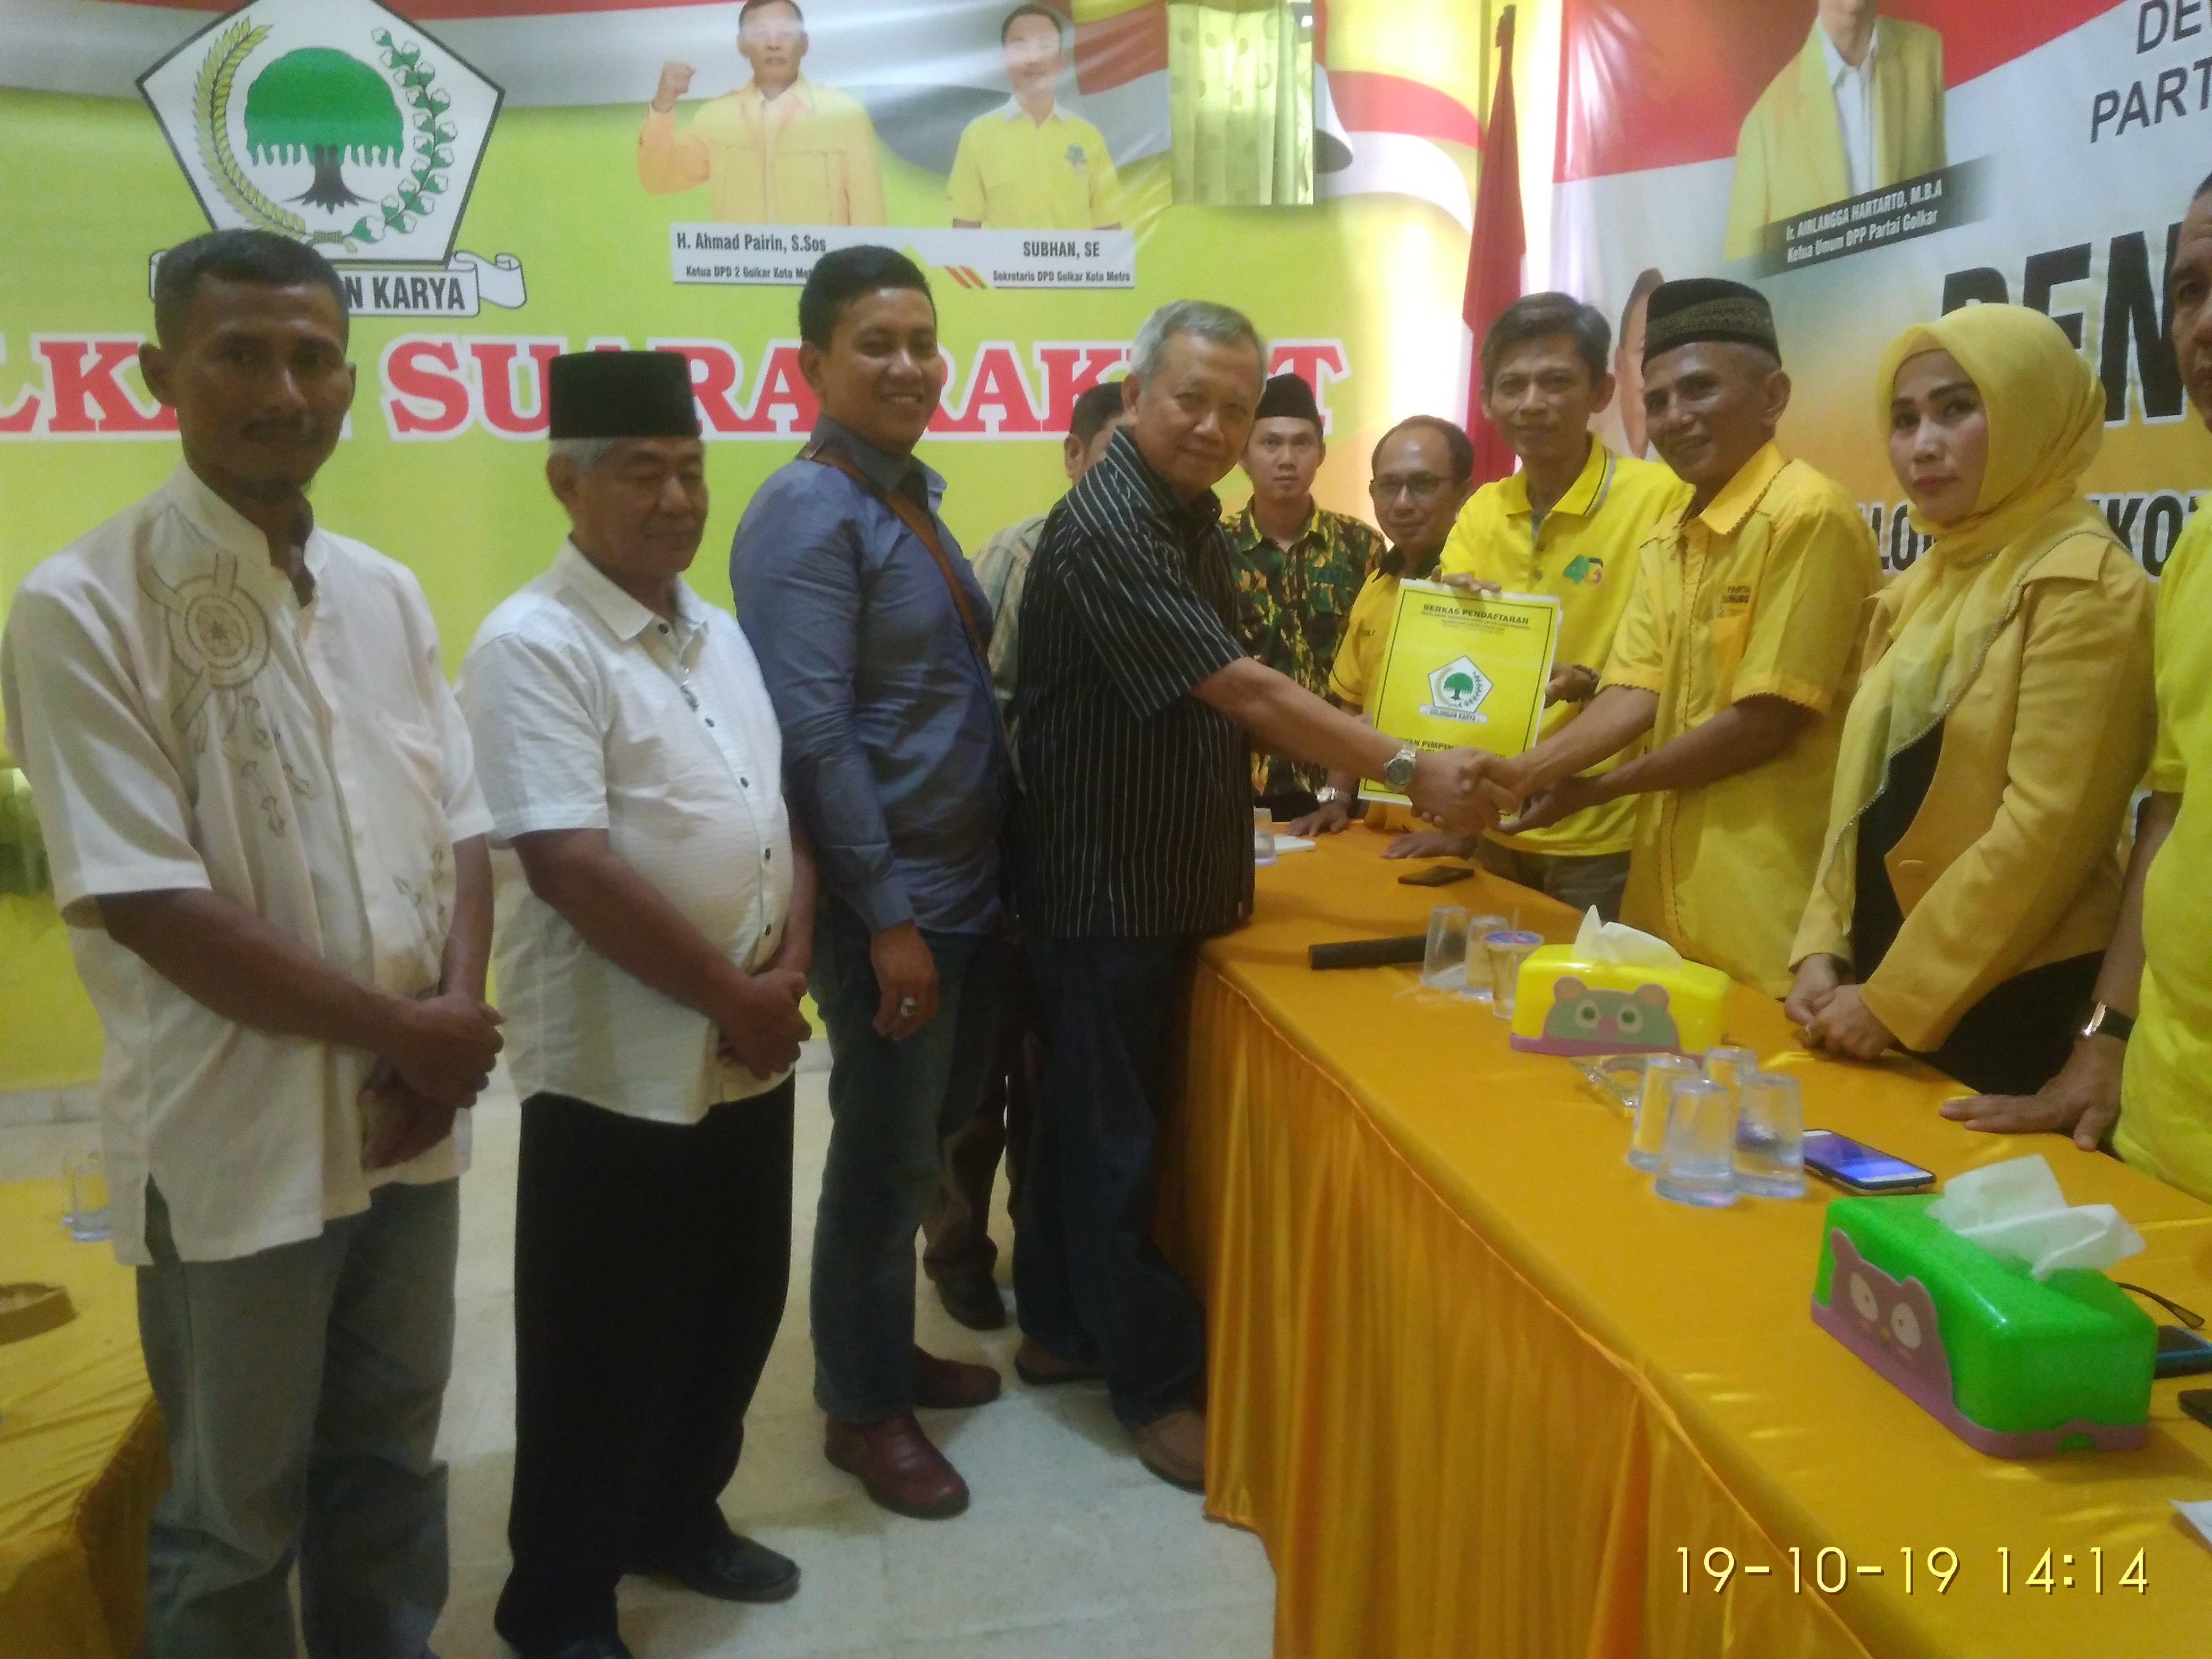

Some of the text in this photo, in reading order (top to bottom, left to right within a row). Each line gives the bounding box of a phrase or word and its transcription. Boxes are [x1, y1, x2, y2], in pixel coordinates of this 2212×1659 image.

[2136, 0, 2212, 54] DE
[1797, 207, 1849, 238] AIRLANGGA
[1910, 179, 1942, 205] M.B.A
[677, 231, 826, 254] H. Ahmad Pairin, S.Sos
[1023, 241, 1100, 259] SUBHAN, SE
[1787, 210, 1939, 264] Ketua Umum DPP Partai Golkar
[686, 265, 711, 277] Ketua
[714, 266, 732, 277] DPD
[735, 266, 740, 278] 2
[743, 266, 770, 278] Golkar
[773, 267, 793, 279] Kota
[993, 270, 1130, 281] Sekretaris DPD Golkar Kota Metro
[373, 276, 466, 310] KARYA
[387, 341, 820, 433] SURA
[1423, 604, 1460, 615] BERKAS
[1462, 609, 1529, 624] PENDAFTARAN
